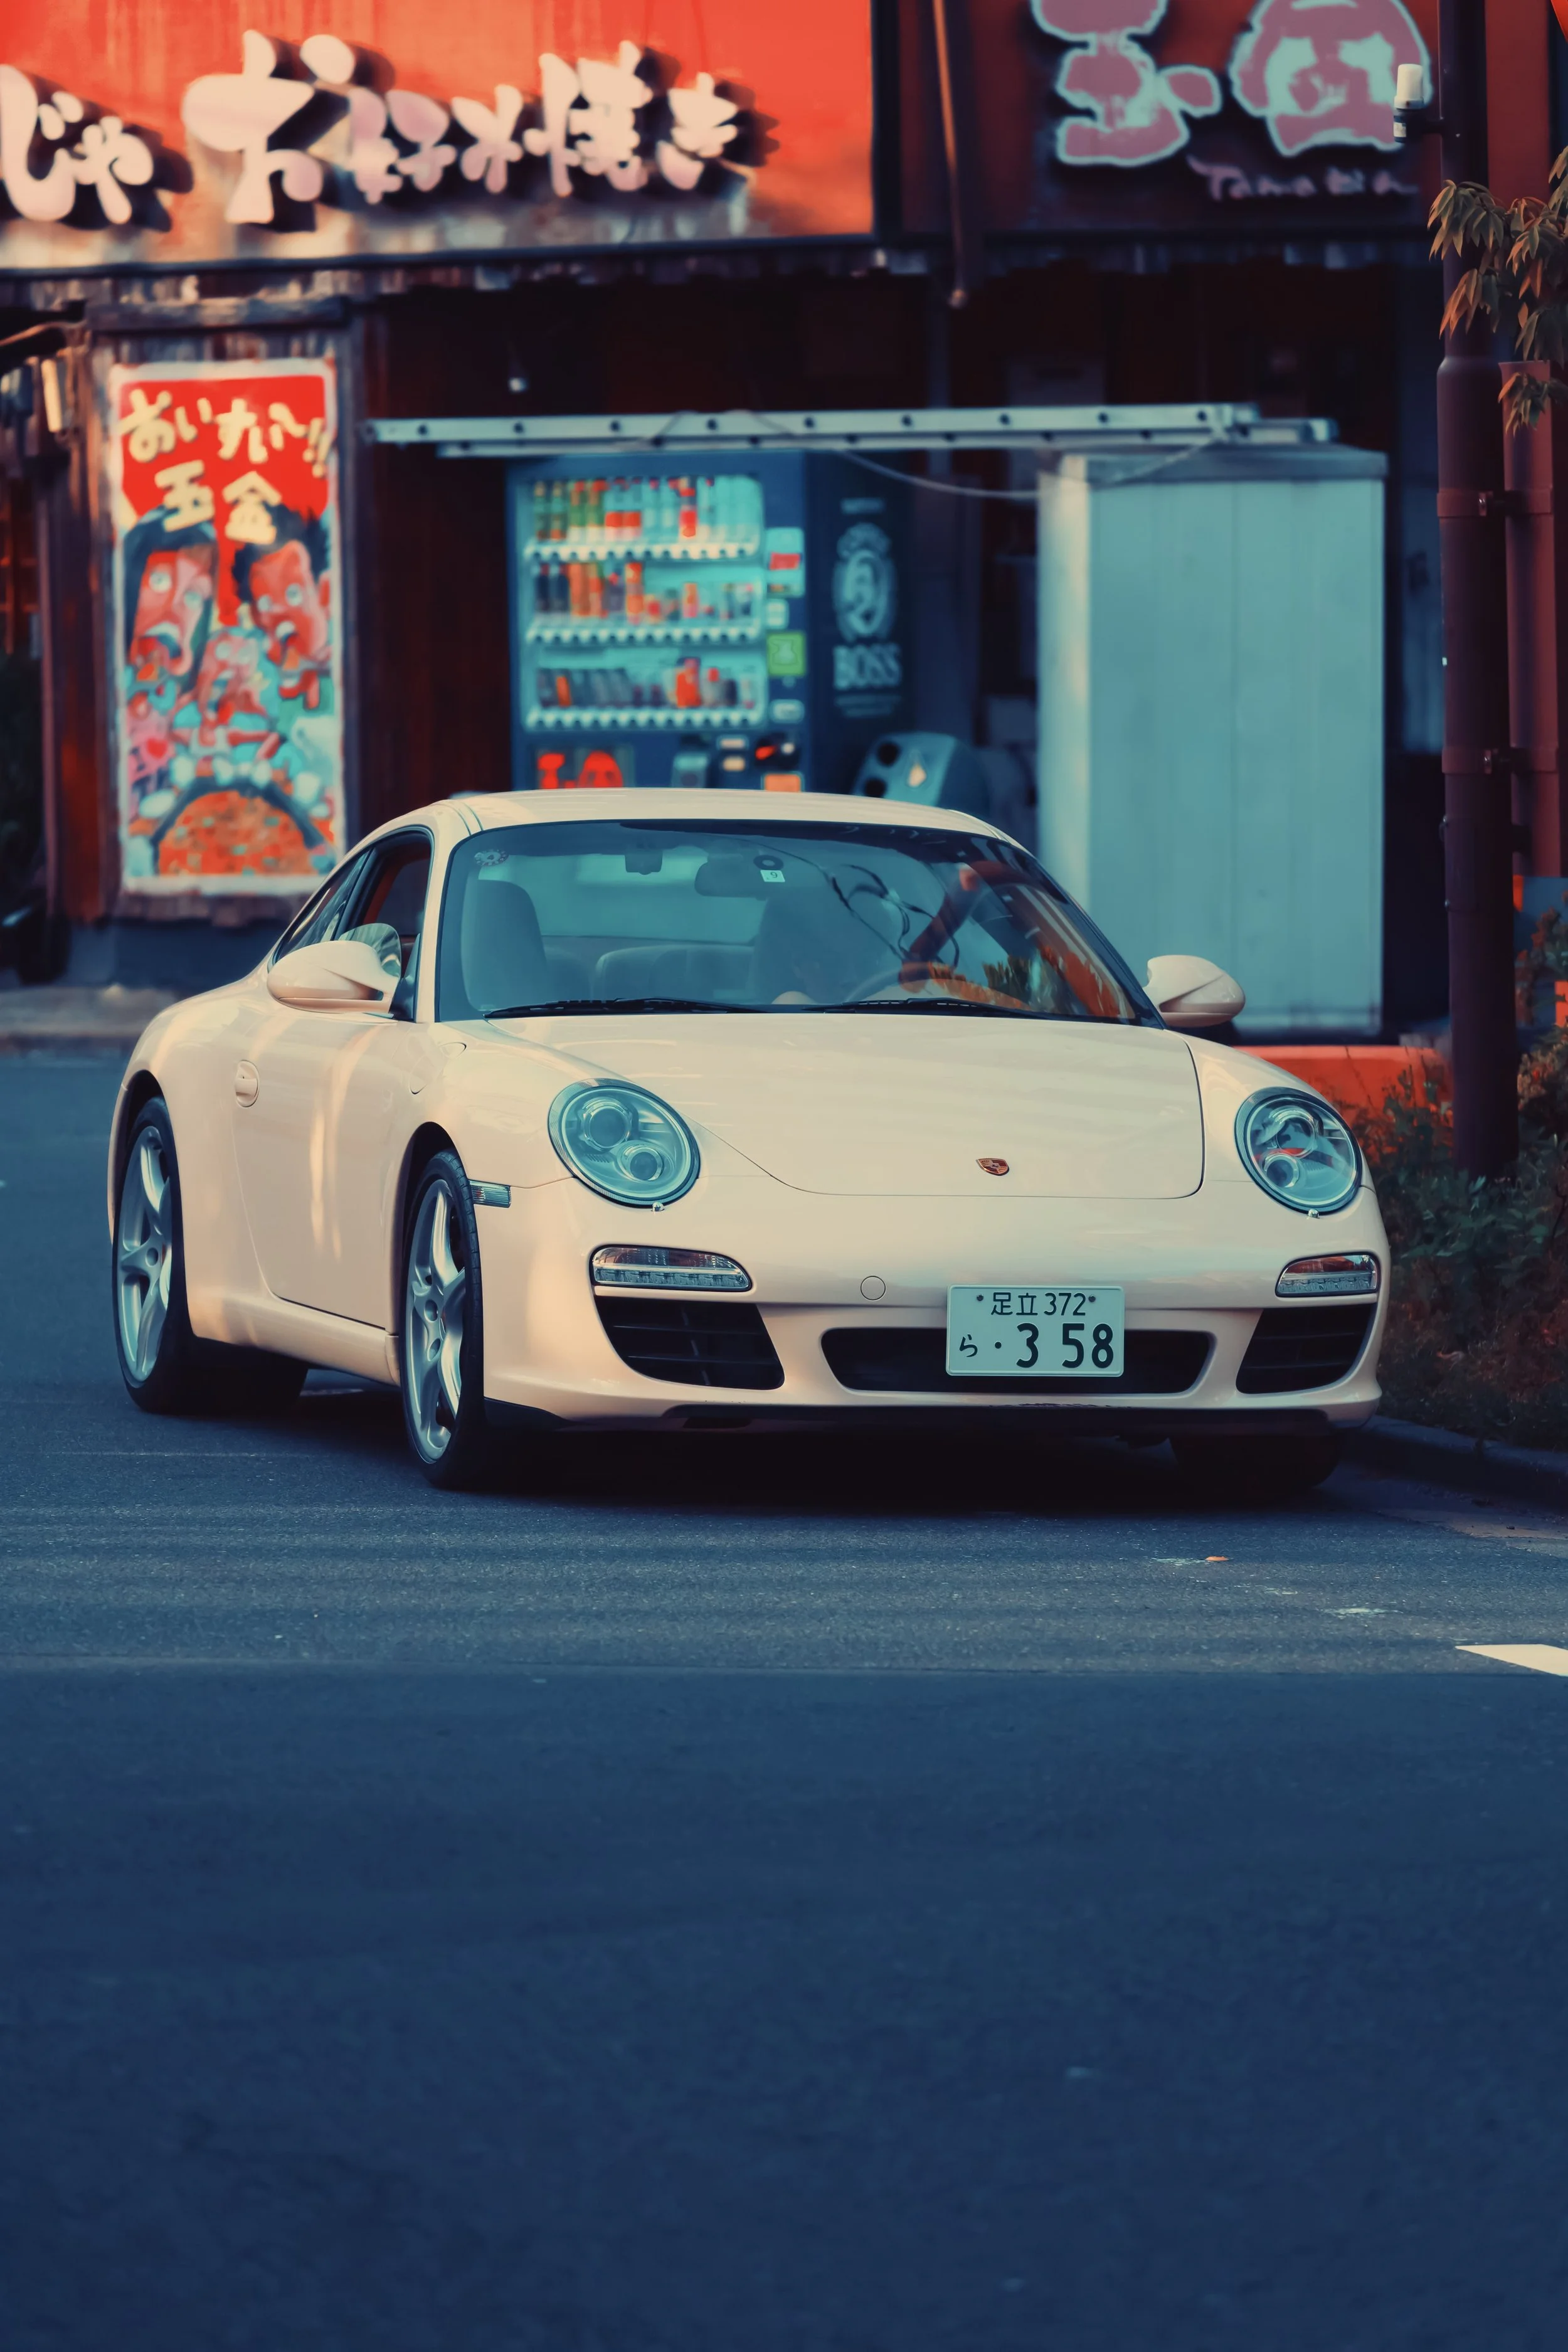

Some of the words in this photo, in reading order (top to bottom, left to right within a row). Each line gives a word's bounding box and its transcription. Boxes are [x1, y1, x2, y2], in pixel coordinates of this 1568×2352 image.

[181, 29, 739, 224] お好み焼き
[991, 1292, 1039, 1316] 足立
[1044, 1292, 1086, 1316] 372
